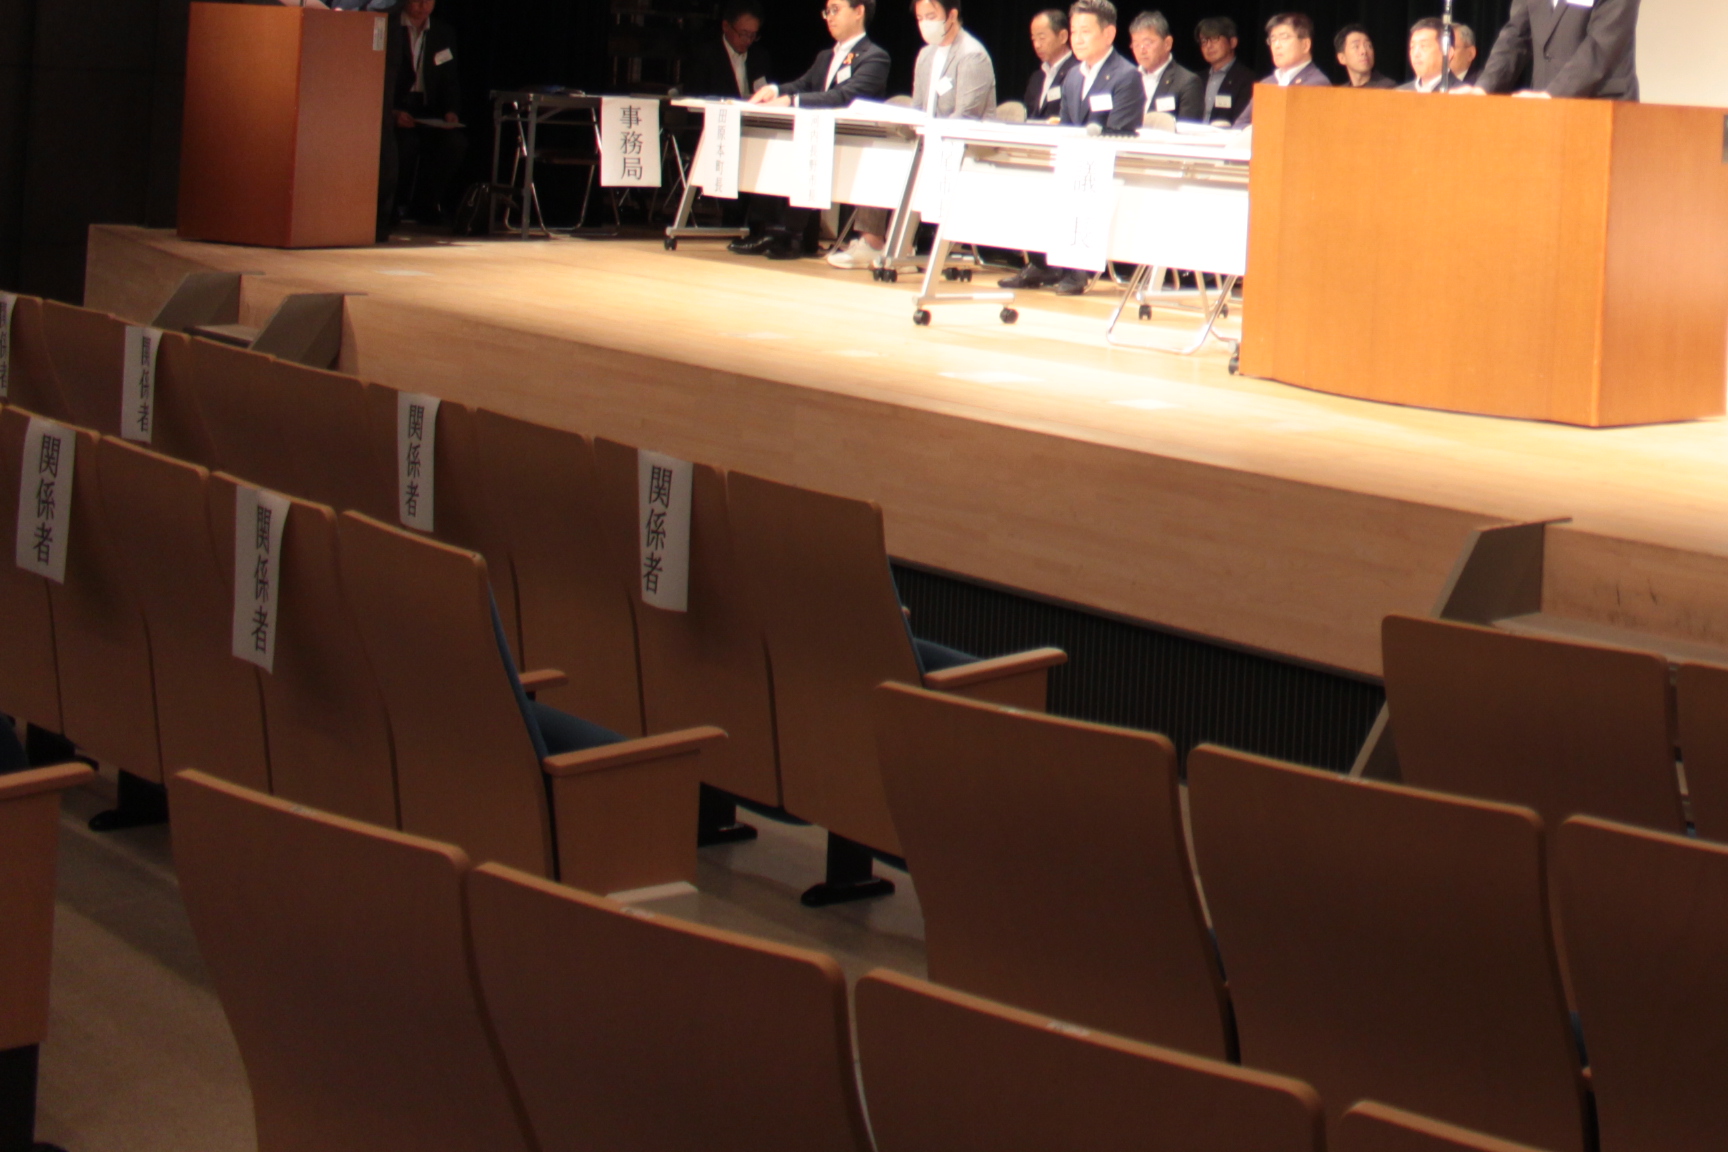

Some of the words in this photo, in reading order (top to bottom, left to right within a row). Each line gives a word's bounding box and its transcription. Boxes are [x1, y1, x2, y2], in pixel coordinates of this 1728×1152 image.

[620, 105, 643, 181] 事務局
[714, 108, 728, 193] 田原本町長
[138, 336, 151, 432] 関係者
[33, 433, 61, 565] 関係者
[405, 404, 424, 517] 関係者
[251, 504, 272, 654] 関係者
[643, 465, 673, 595] 関係者
